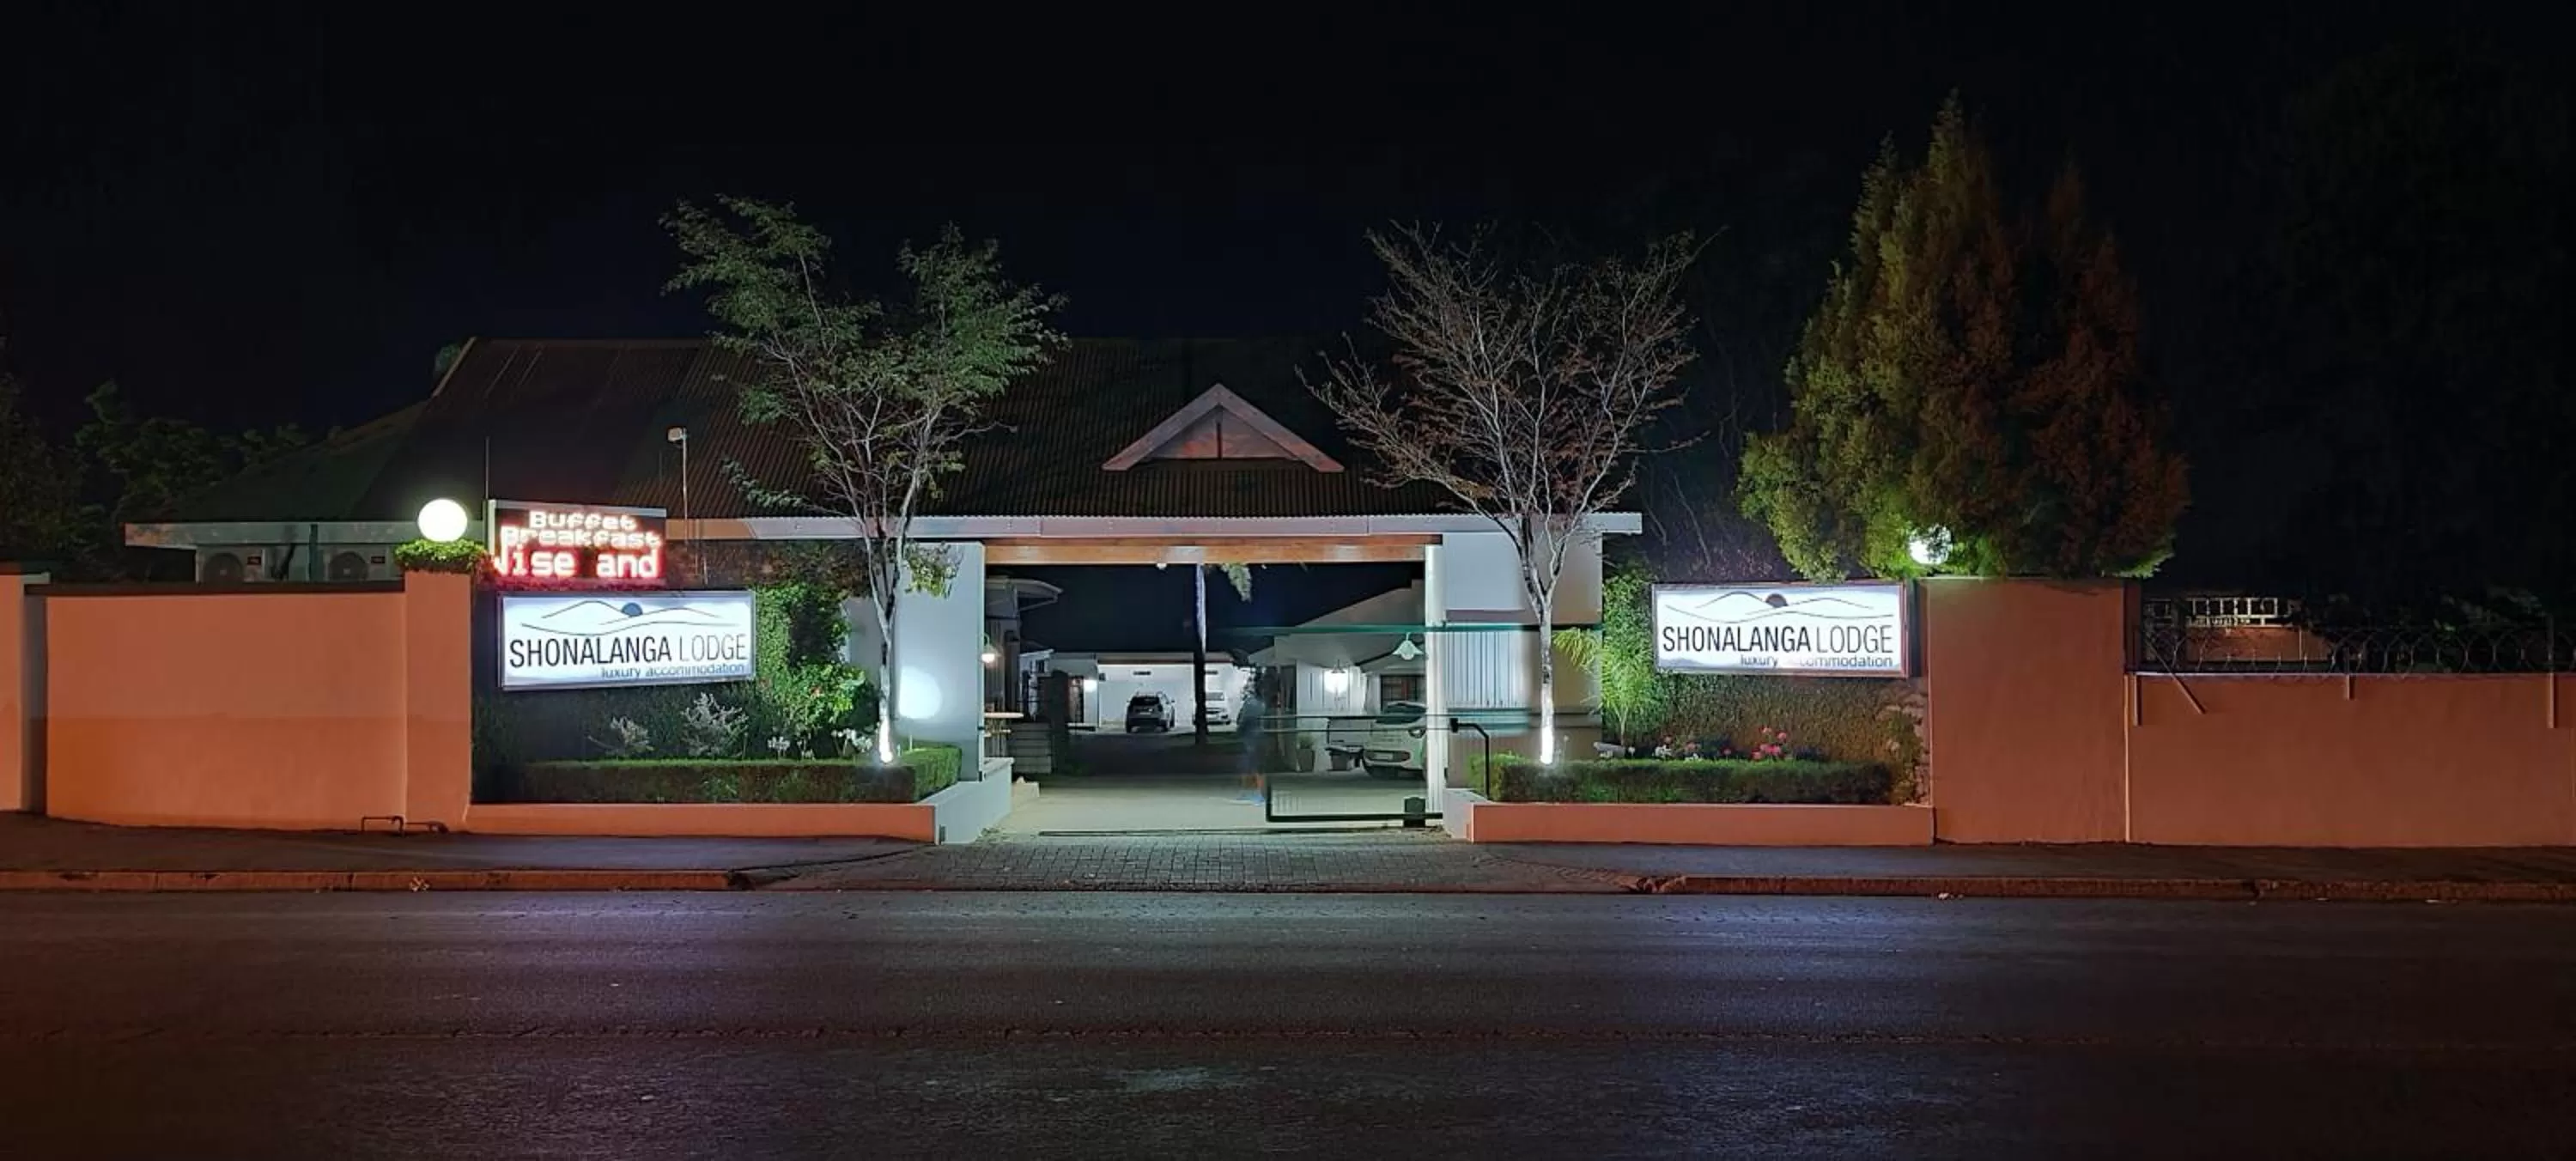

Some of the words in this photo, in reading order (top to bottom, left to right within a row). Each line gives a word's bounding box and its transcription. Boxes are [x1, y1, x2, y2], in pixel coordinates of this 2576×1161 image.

[530, 511, 637, 531] Buffet
[598, 548, 658, 577] and
[509, 636, 671, 668] SHONALANGA
[679, 634, 748, 662] LODGE
[1662, 626, 1811, 653] SHONALANGA
[1816, 625, 1893, 653] LODGE
[602, 666, 641, 678] luxury
[646, 663, 744, 677] accommodation
[1741, 654, 1778, 668] luxury
[1785, 655, 1893, 667] commodation
